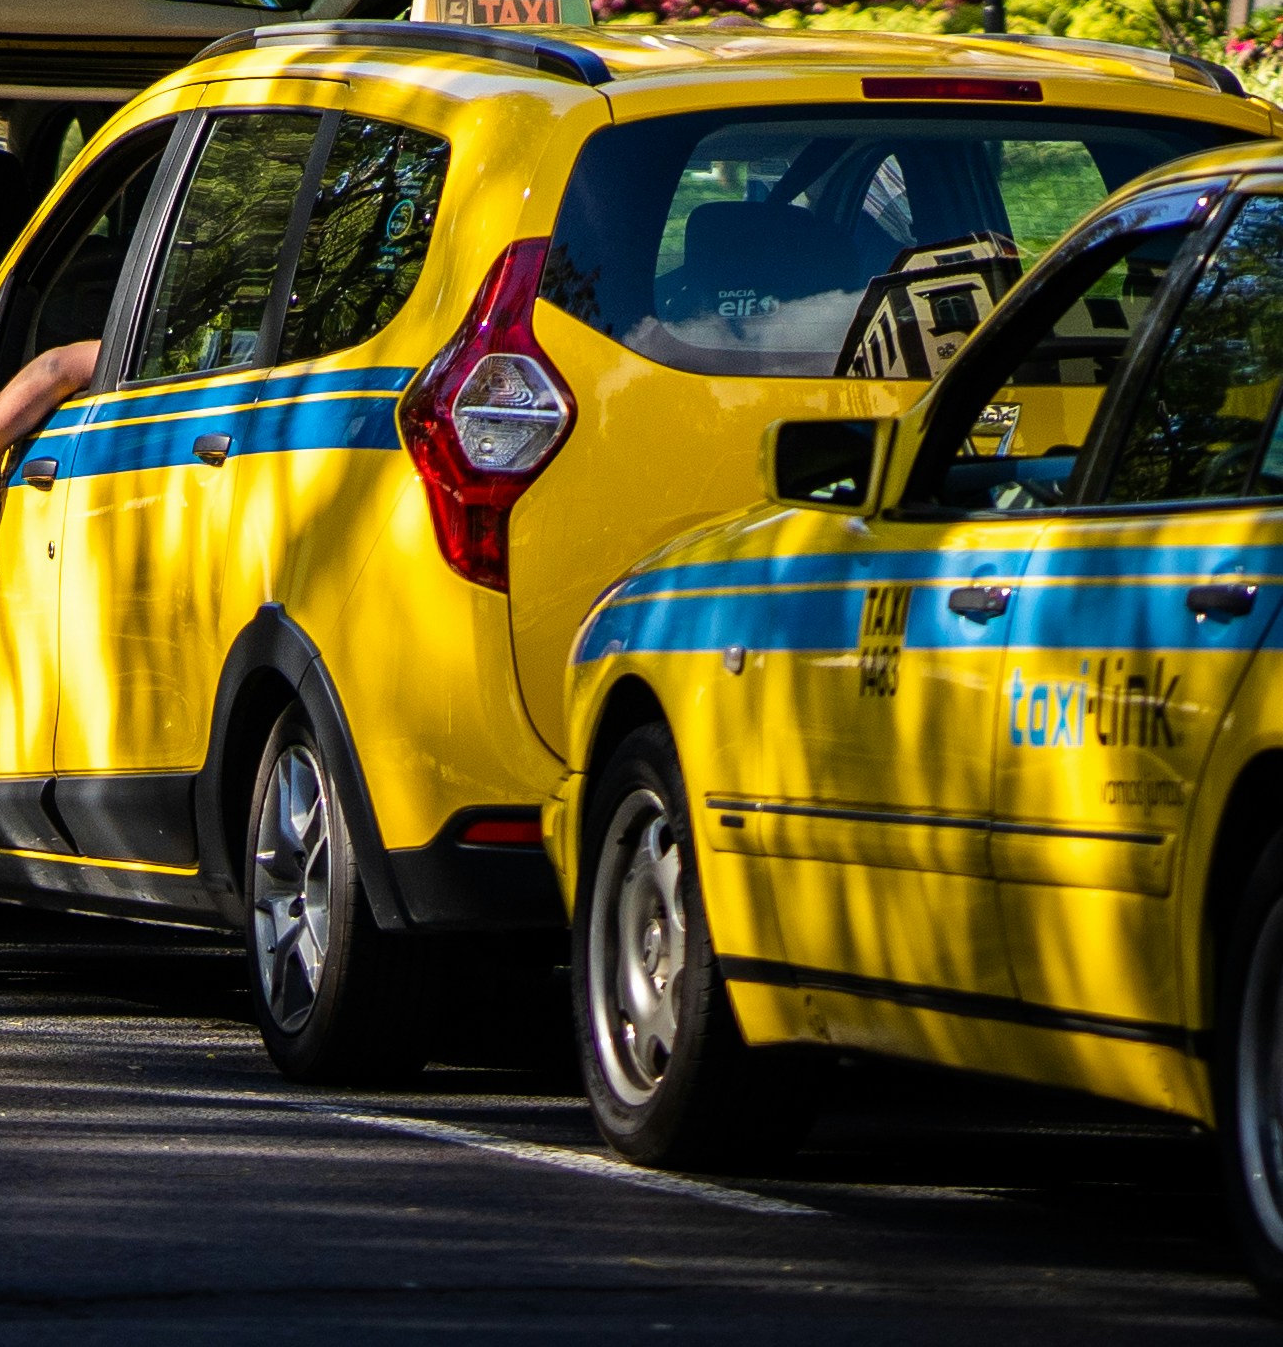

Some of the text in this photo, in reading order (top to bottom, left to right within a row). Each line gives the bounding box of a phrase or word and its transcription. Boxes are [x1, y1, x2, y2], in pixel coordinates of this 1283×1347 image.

[718, 289, 756, 299] DACIA
[718, 298, 757, 317] elf
[863, 586, 913, 637] TAXI
